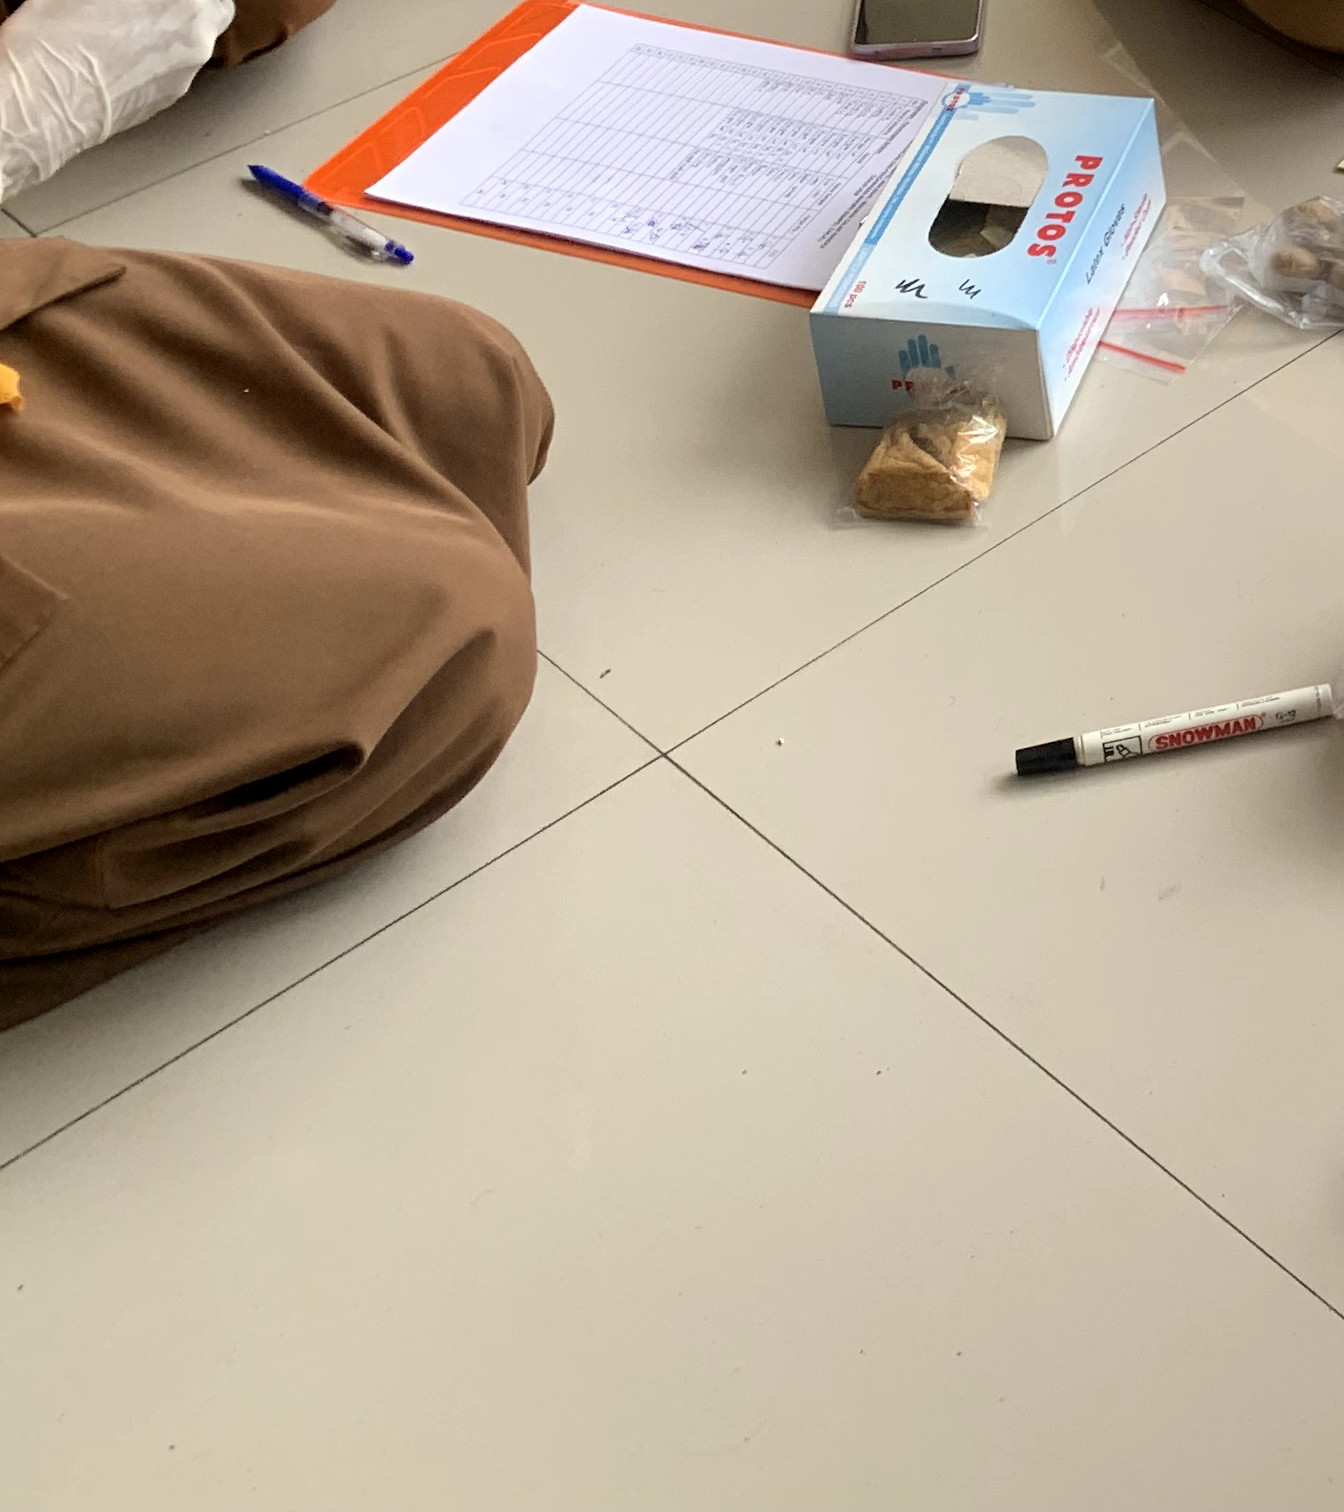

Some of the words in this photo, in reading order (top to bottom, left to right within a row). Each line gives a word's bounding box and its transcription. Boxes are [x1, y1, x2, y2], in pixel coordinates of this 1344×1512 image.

[1027, 155, 1103, 259] PROTOS
[1086, 246, 1104, 284] Latex
[1104, 203, 1125, 247] Gloves
[1155, 717, 1256, 752] SNOWMAN
